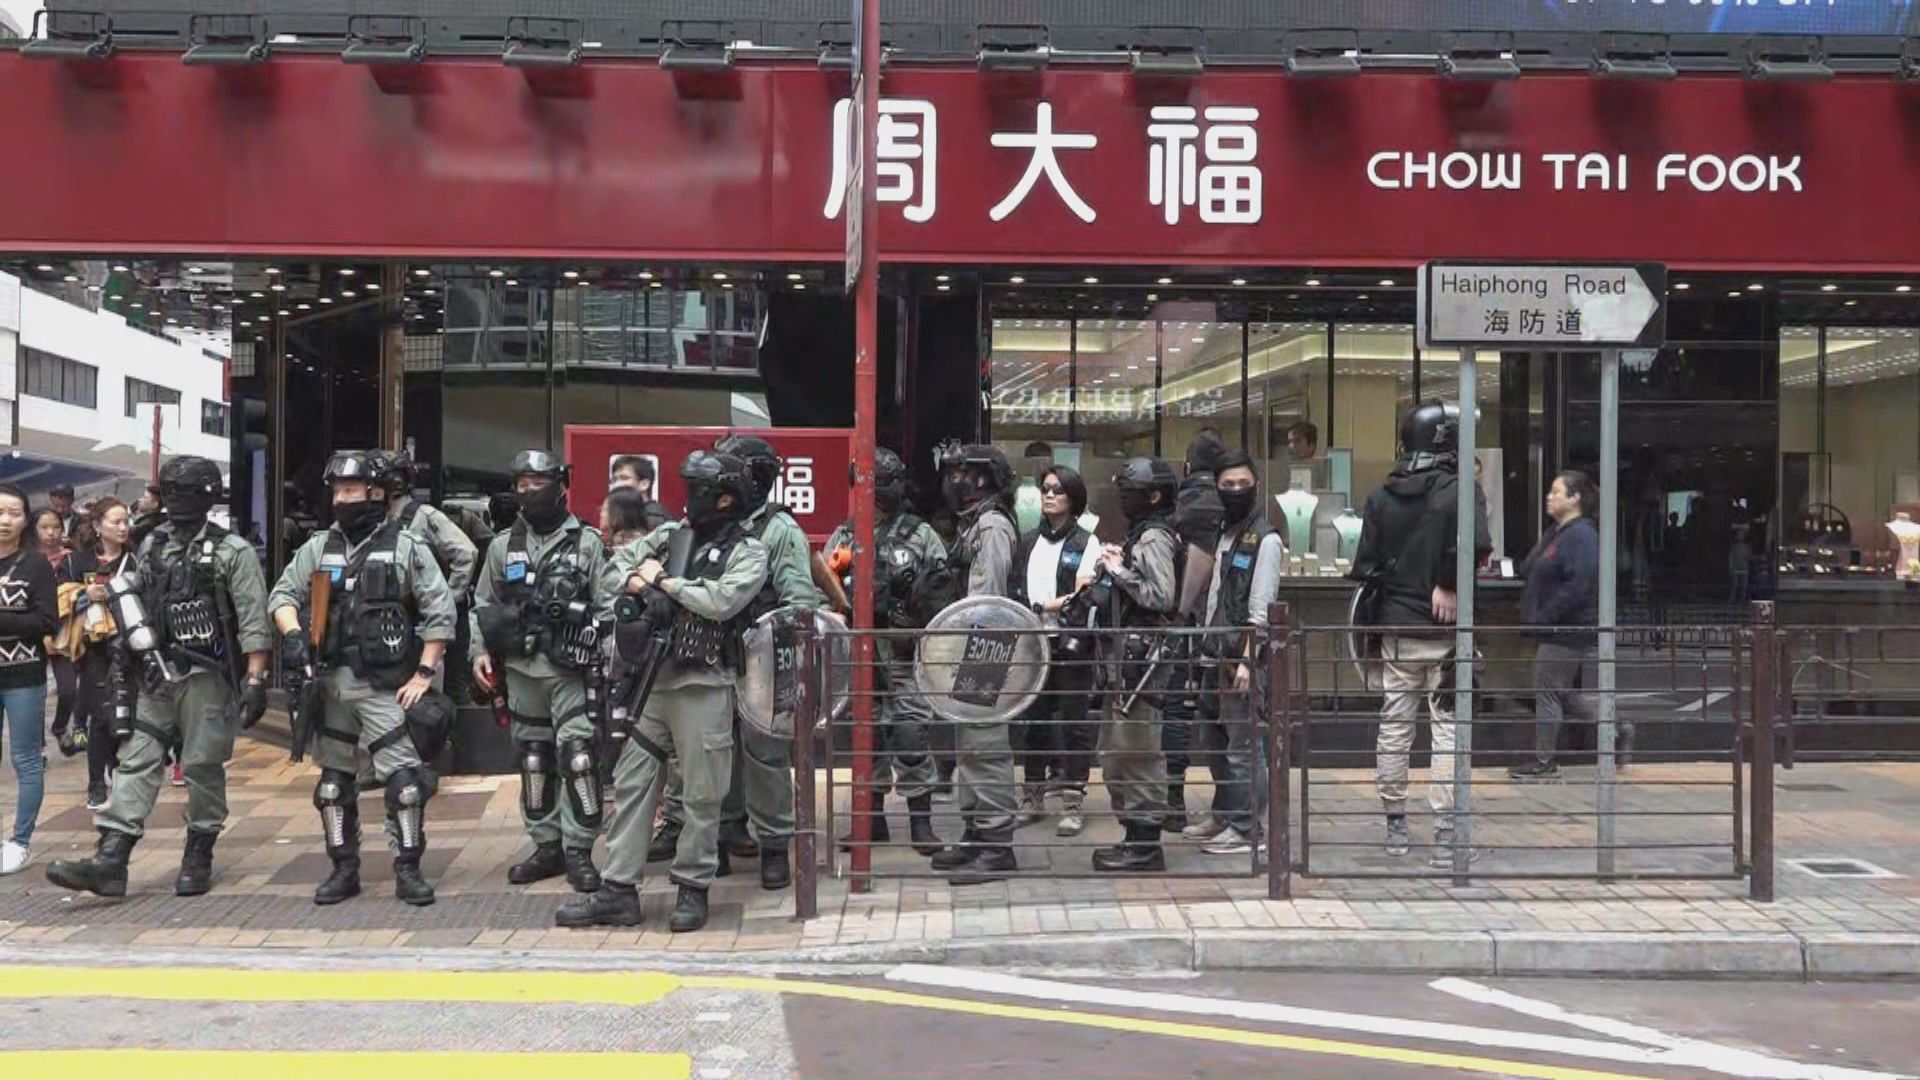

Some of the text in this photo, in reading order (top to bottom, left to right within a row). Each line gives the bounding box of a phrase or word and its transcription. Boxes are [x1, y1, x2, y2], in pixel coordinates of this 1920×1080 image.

[824, 98, 1262, 224] 周大福
[1366, 151, 1803, 192] CHOW TAI FOOK
[1441, 273, 1626, 298] Haiphong Road
[1484, 308, 1583, 335] 海防道
[967, 636, 1012, 663] POLICE
